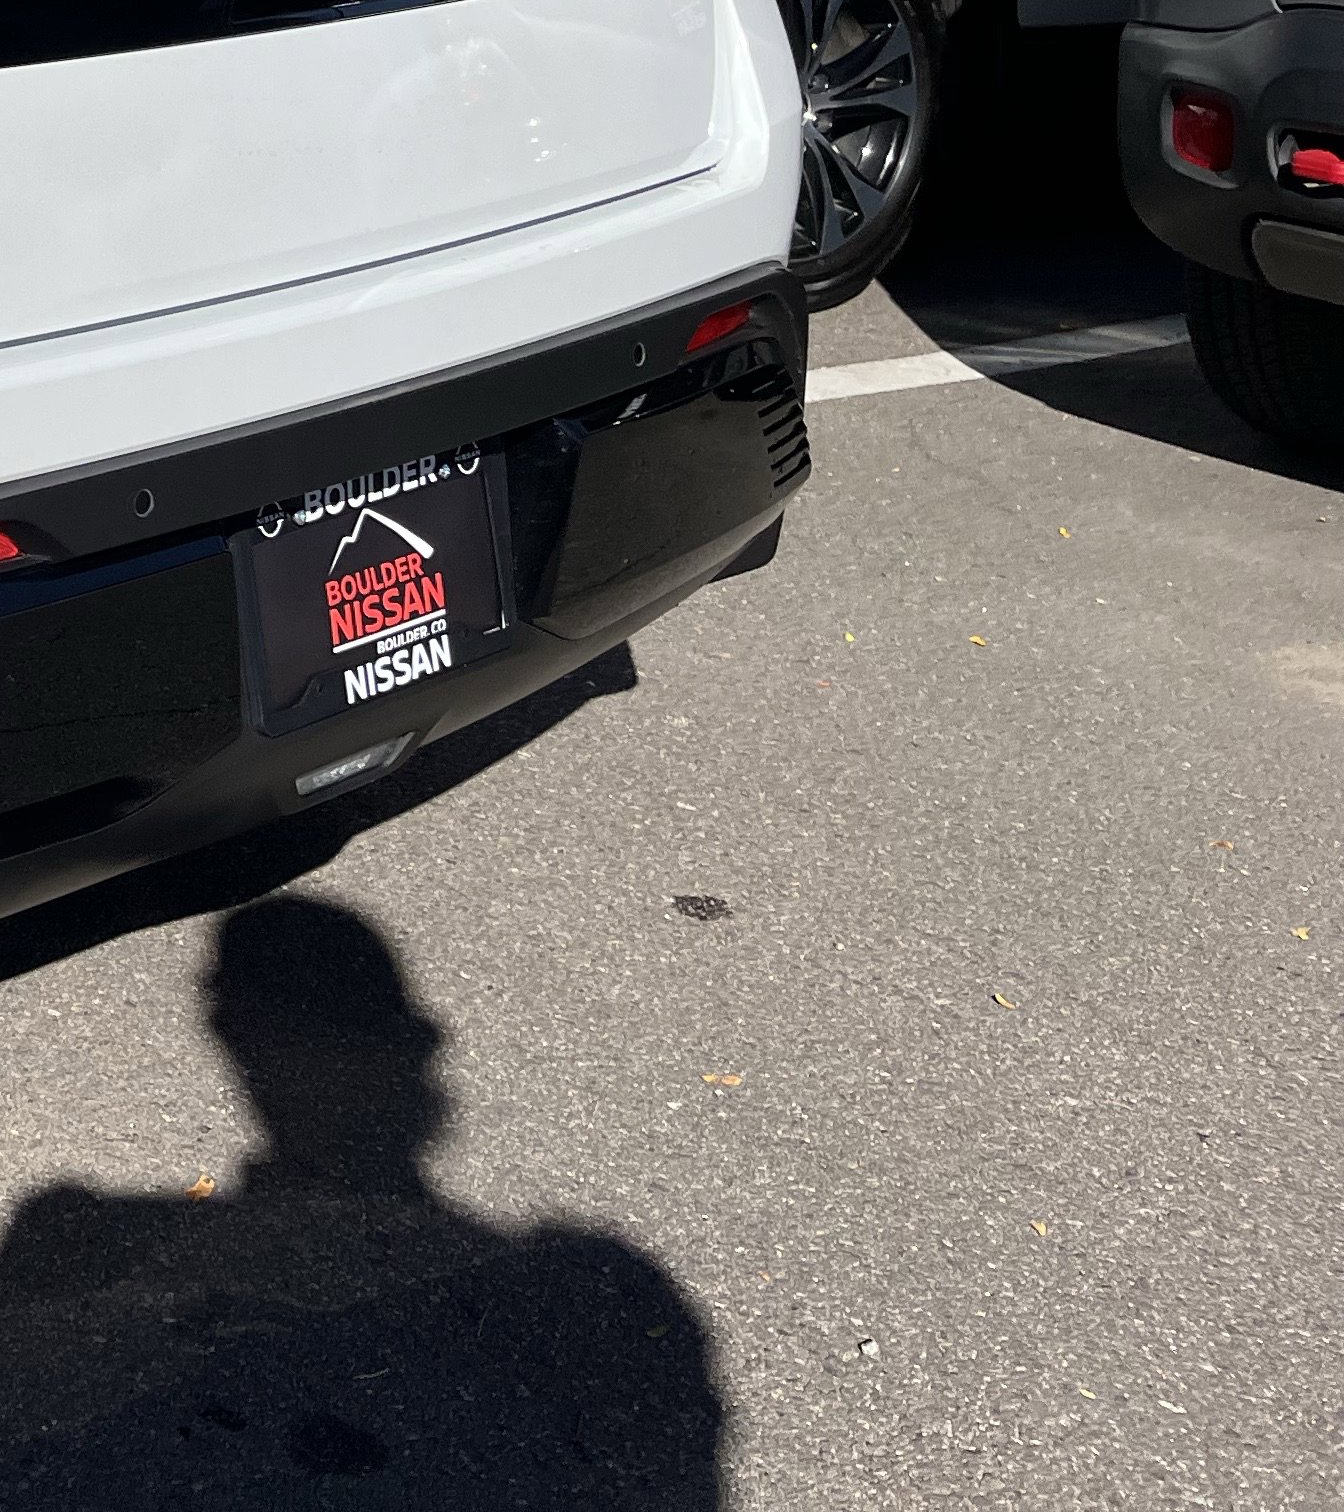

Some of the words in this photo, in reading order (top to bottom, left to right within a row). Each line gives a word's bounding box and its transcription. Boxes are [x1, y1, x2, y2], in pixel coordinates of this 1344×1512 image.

[304, 454, 438, 523] BOULDER
[325, 552, 425, 607] BOULDER
[329, 571, 446, 646] NISSAN
[430, 618, 447, 633] CO
[343, 634, 452, 705] NISSAN
